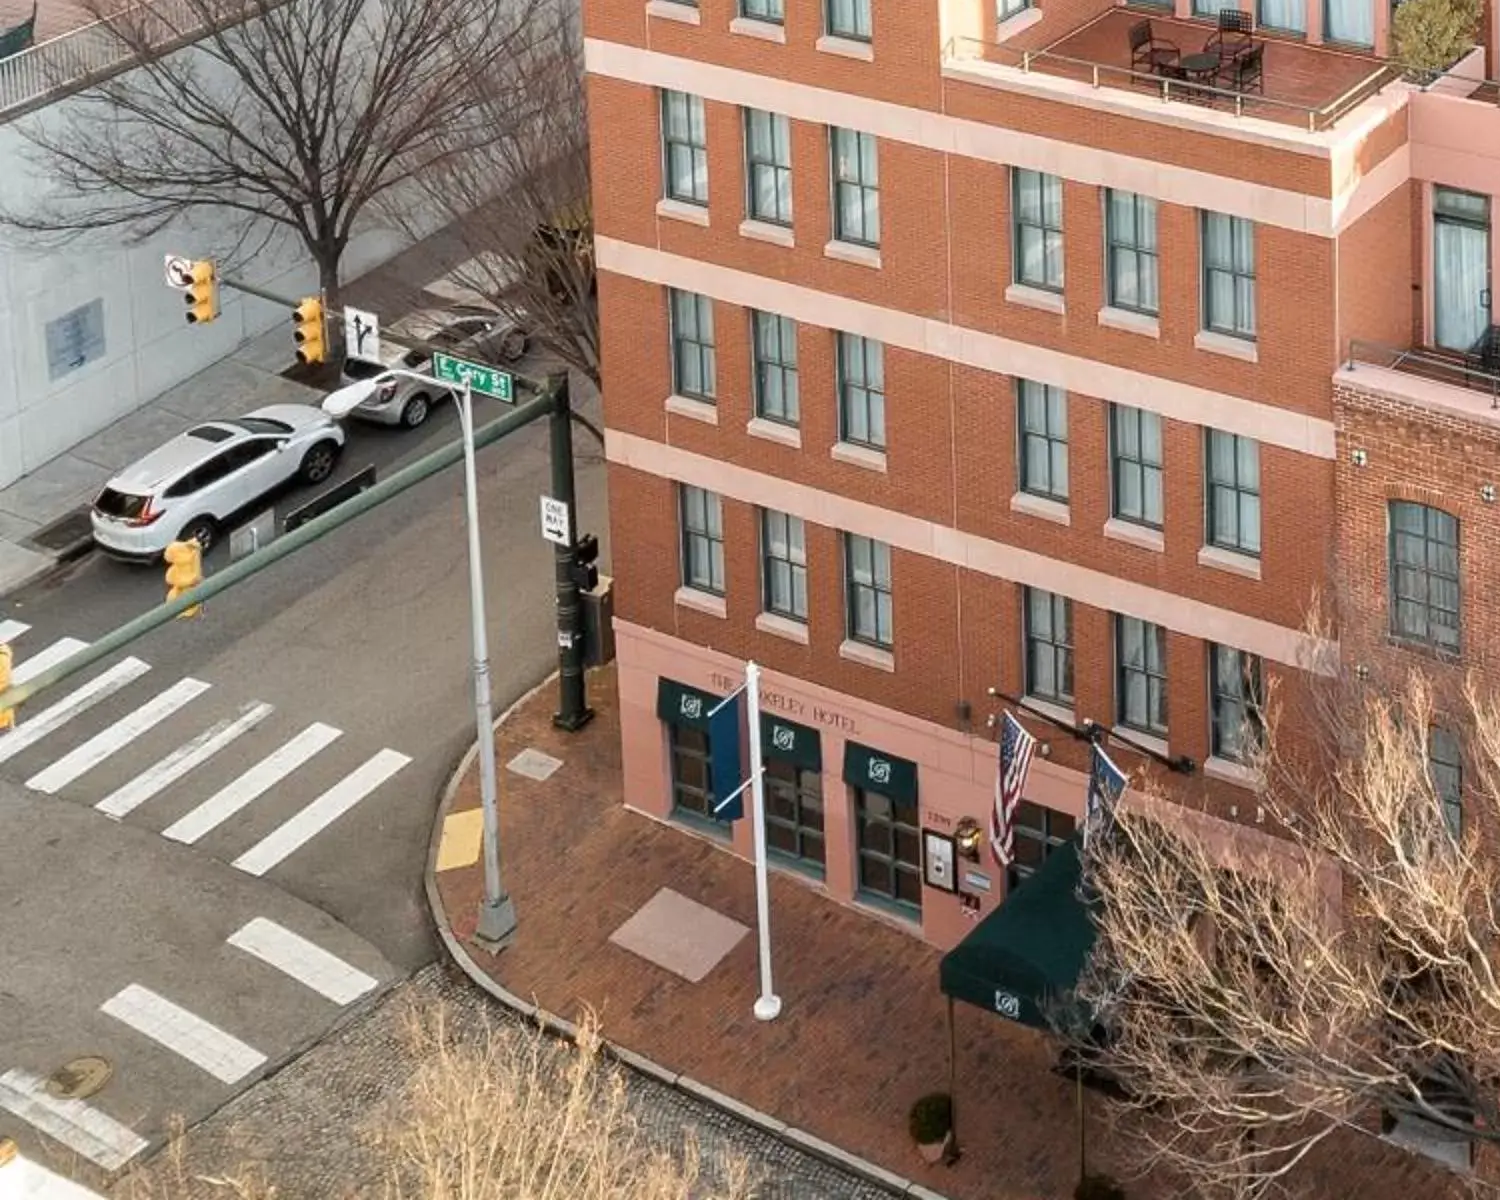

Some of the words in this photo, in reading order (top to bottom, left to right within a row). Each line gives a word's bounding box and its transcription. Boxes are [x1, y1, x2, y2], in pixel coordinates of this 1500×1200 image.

[491, 372, 507, 390] St
[545, 502, 565, 516] ONE
[545, 513, 566, 528] WAY
[707, 672, 734, 691] THE
[811, 704, 862, 735] HOTEL
